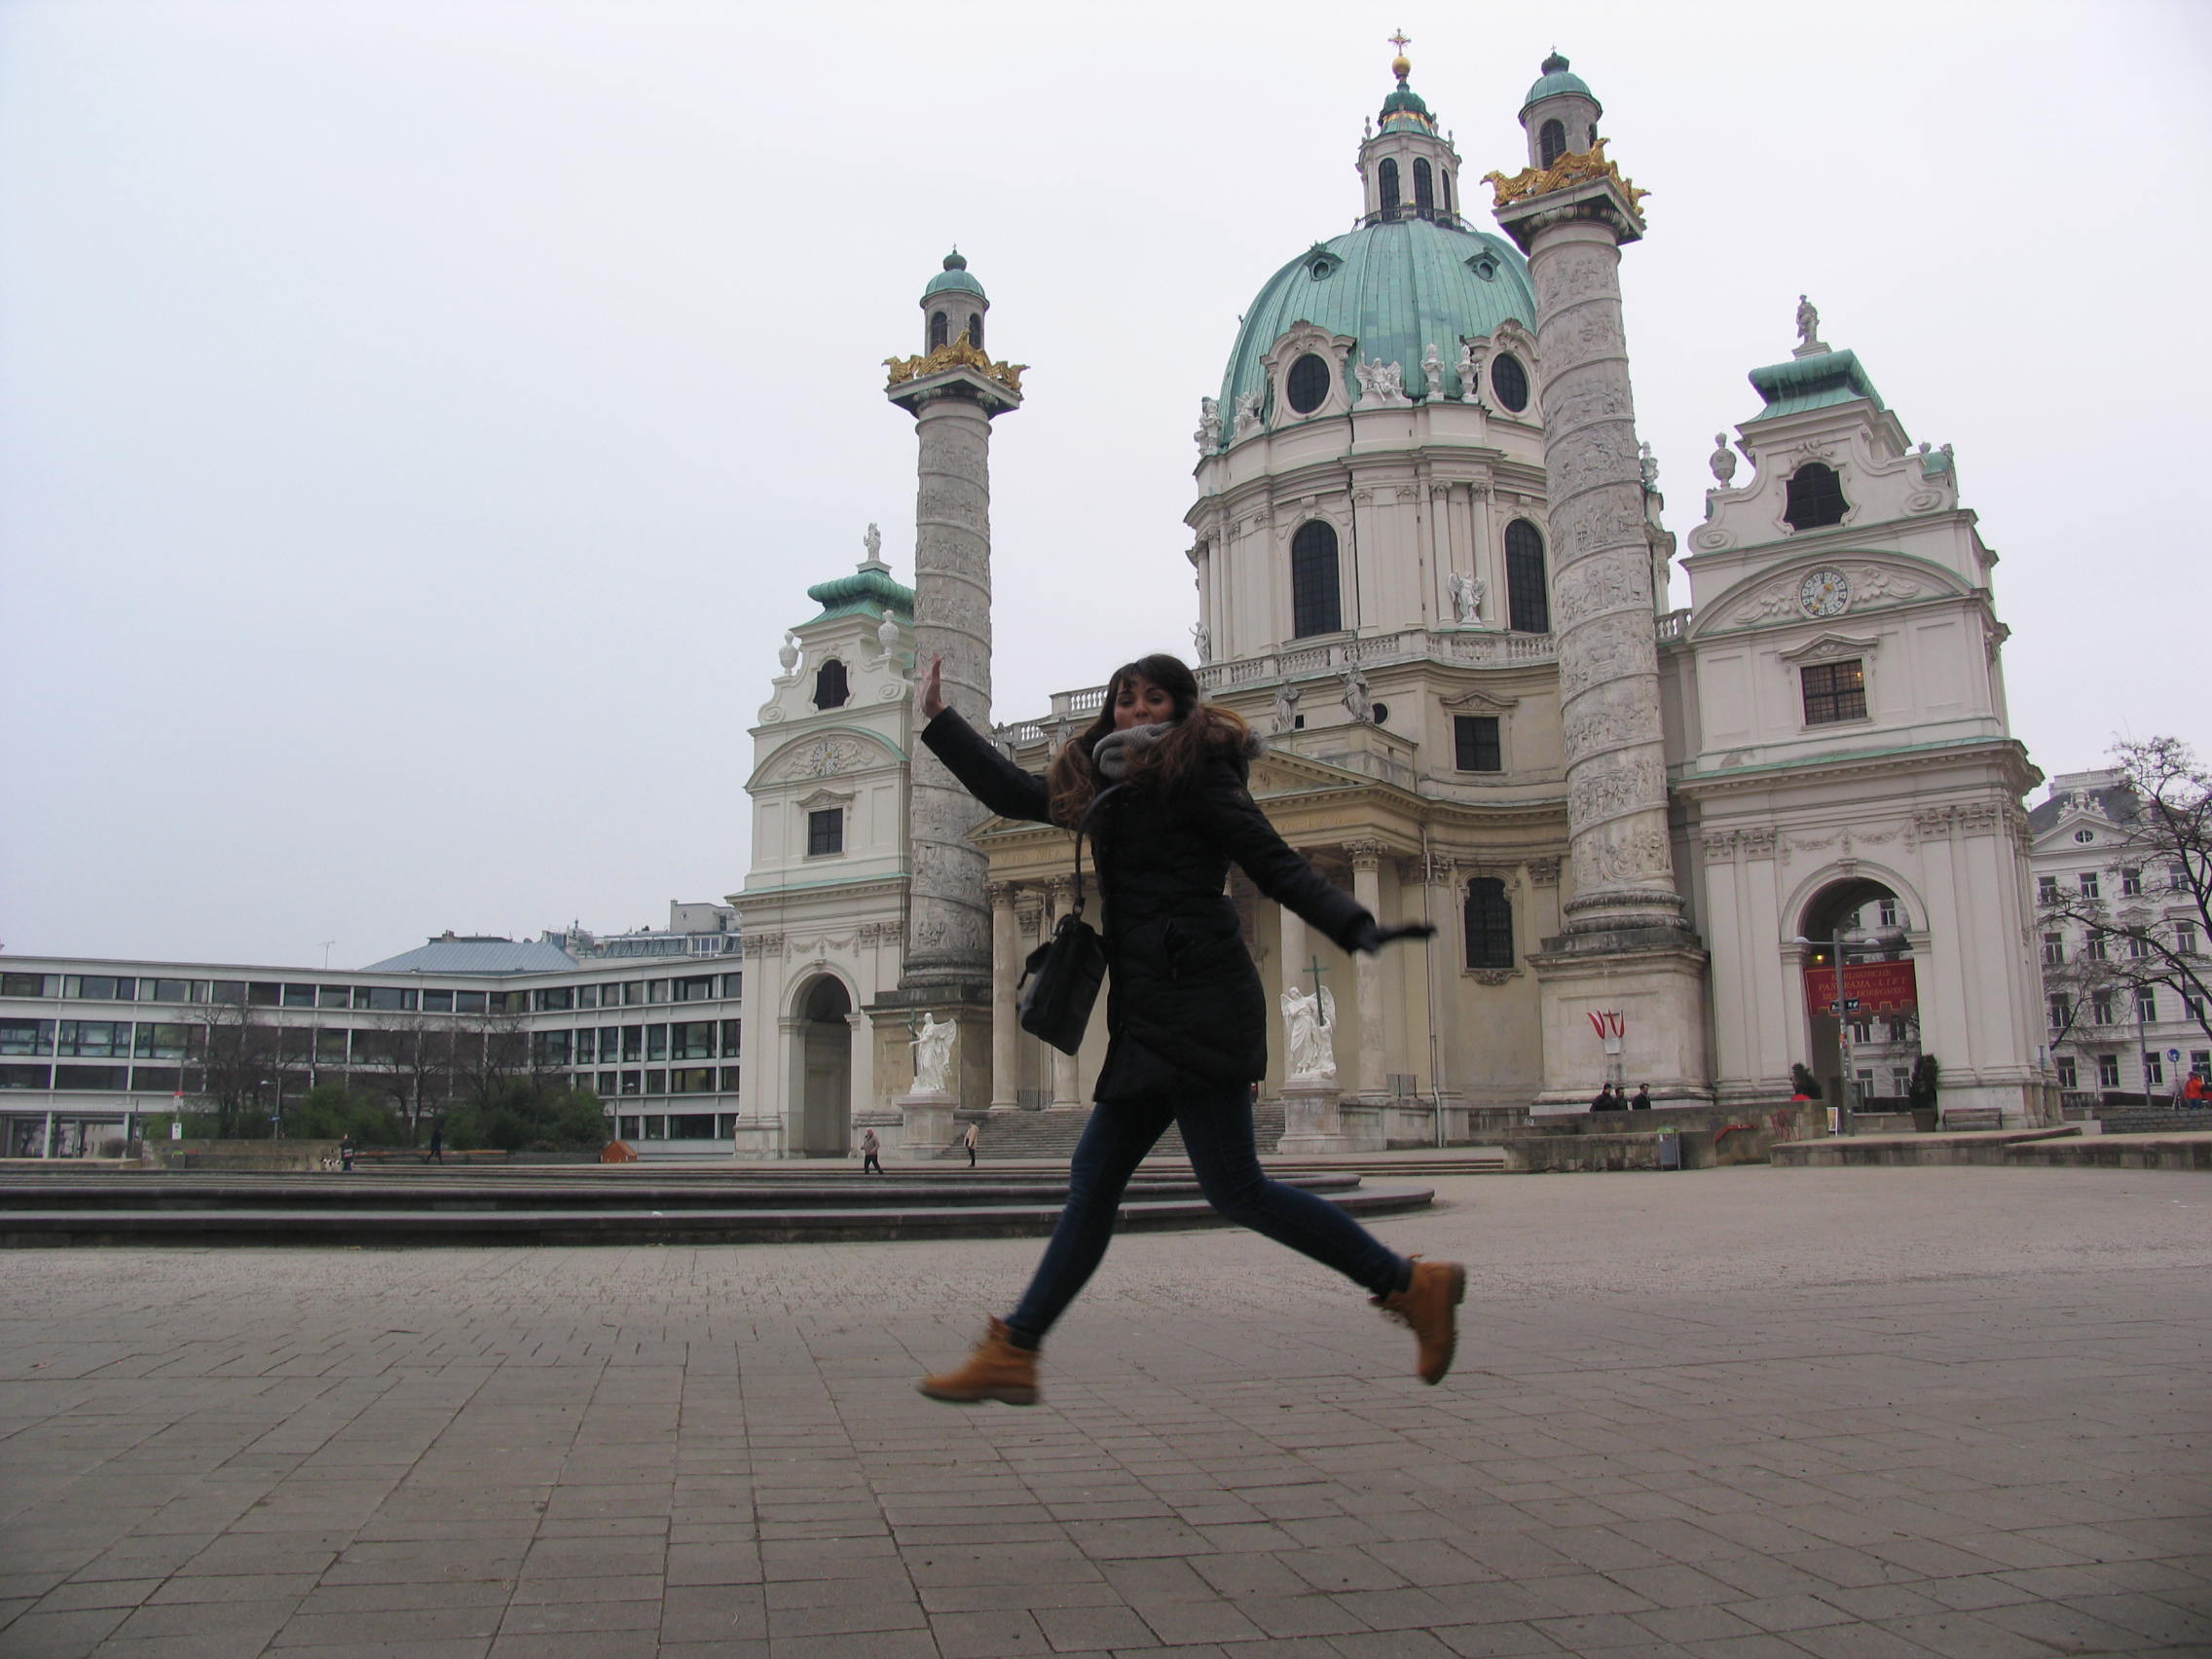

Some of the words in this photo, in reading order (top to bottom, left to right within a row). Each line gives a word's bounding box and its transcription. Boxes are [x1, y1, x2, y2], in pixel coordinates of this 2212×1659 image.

[1831, 969, 1891, 980] KRLSKIRCHE
[1818, 980, 1870, 991] PANRAMA
[1823, 990, 1853, 1000] MUSO
